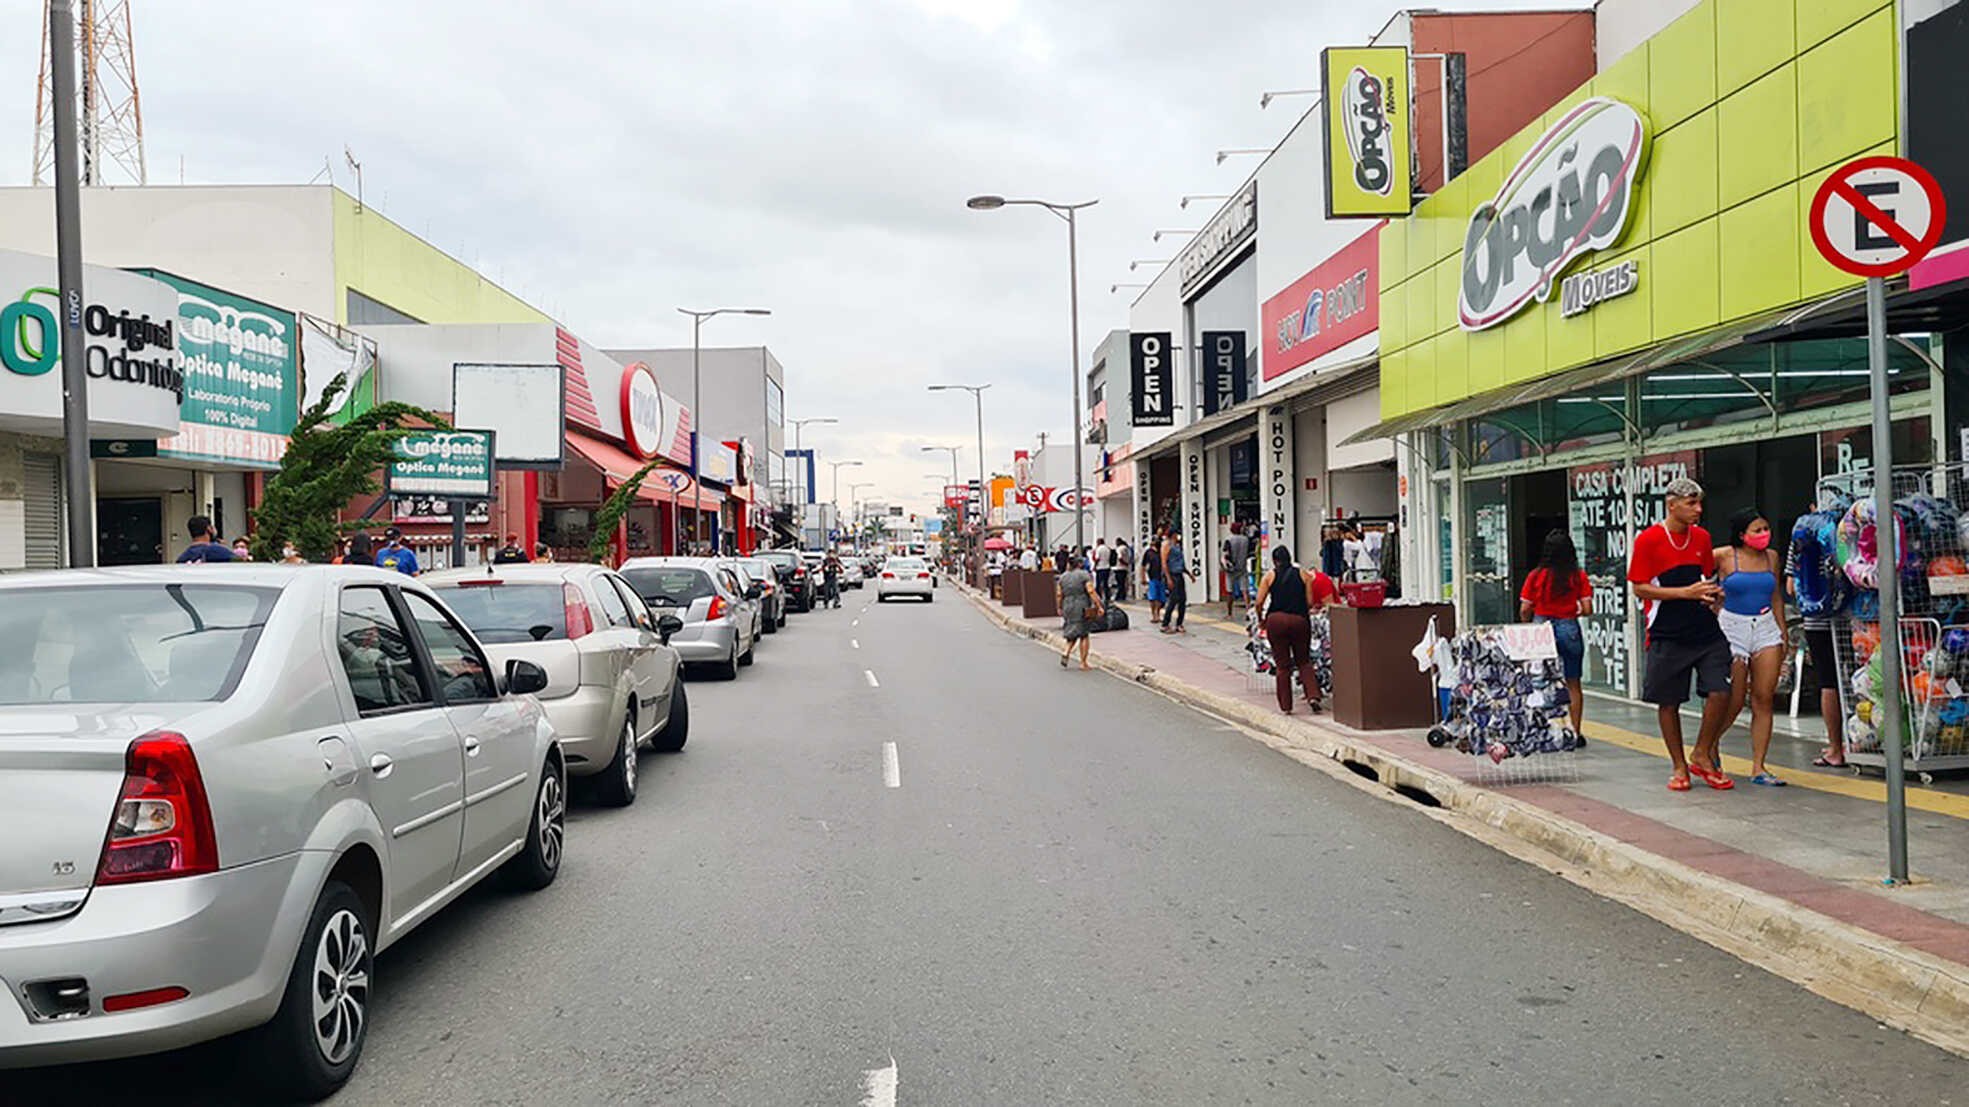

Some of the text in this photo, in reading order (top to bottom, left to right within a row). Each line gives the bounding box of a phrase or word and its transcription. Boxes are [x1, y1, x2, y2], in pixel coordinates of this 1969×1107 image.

[1353, 76, 1390, 191] OPÇÃO
[1463, 141, 1626, 313] OPÇÃO
[1854, 181, 1900, 251] E
[85, 304, 174, 352] Original
[1277, 267, 1368, 354] HOT POINT
[1141, 336, 1162, 412] OPEN
[205, 408, 258, 428] 100% Digital
[1135, 416, 1171, 424] SHOPPING
[1139, 472, 1150, 548] OPEN SHOPP
[1189, 454, 1202, 577] OPEN SHOPPING
[1272, 422, 1286, 540] HOT POINT
[1575, 471, 1608, 497] CASA
